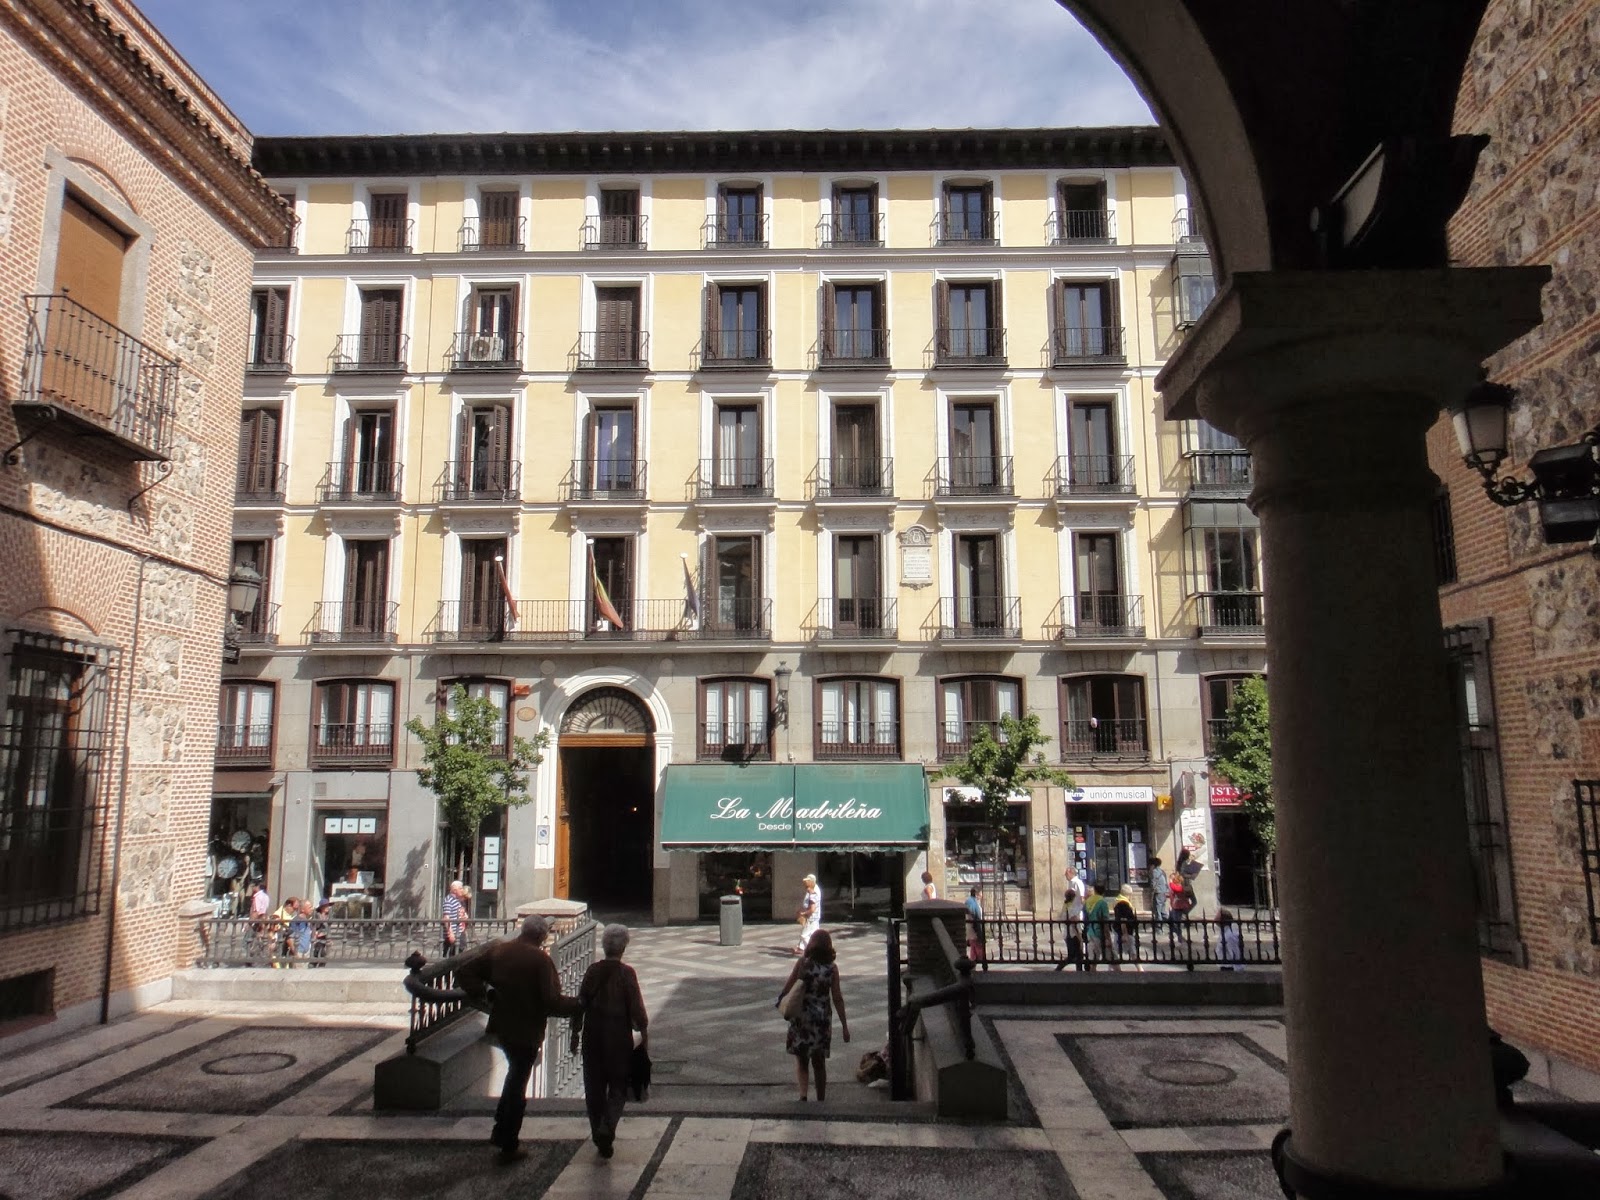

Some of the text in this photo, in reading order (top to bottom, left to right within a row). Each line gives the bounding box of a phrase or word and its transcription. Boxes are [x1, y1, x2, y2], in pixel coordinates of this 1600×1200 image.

[1089, 789, 1147, 799] unión musical
[710, 796, 883, 820] La Madrileña
[758, 822, 791, 831] Desde
